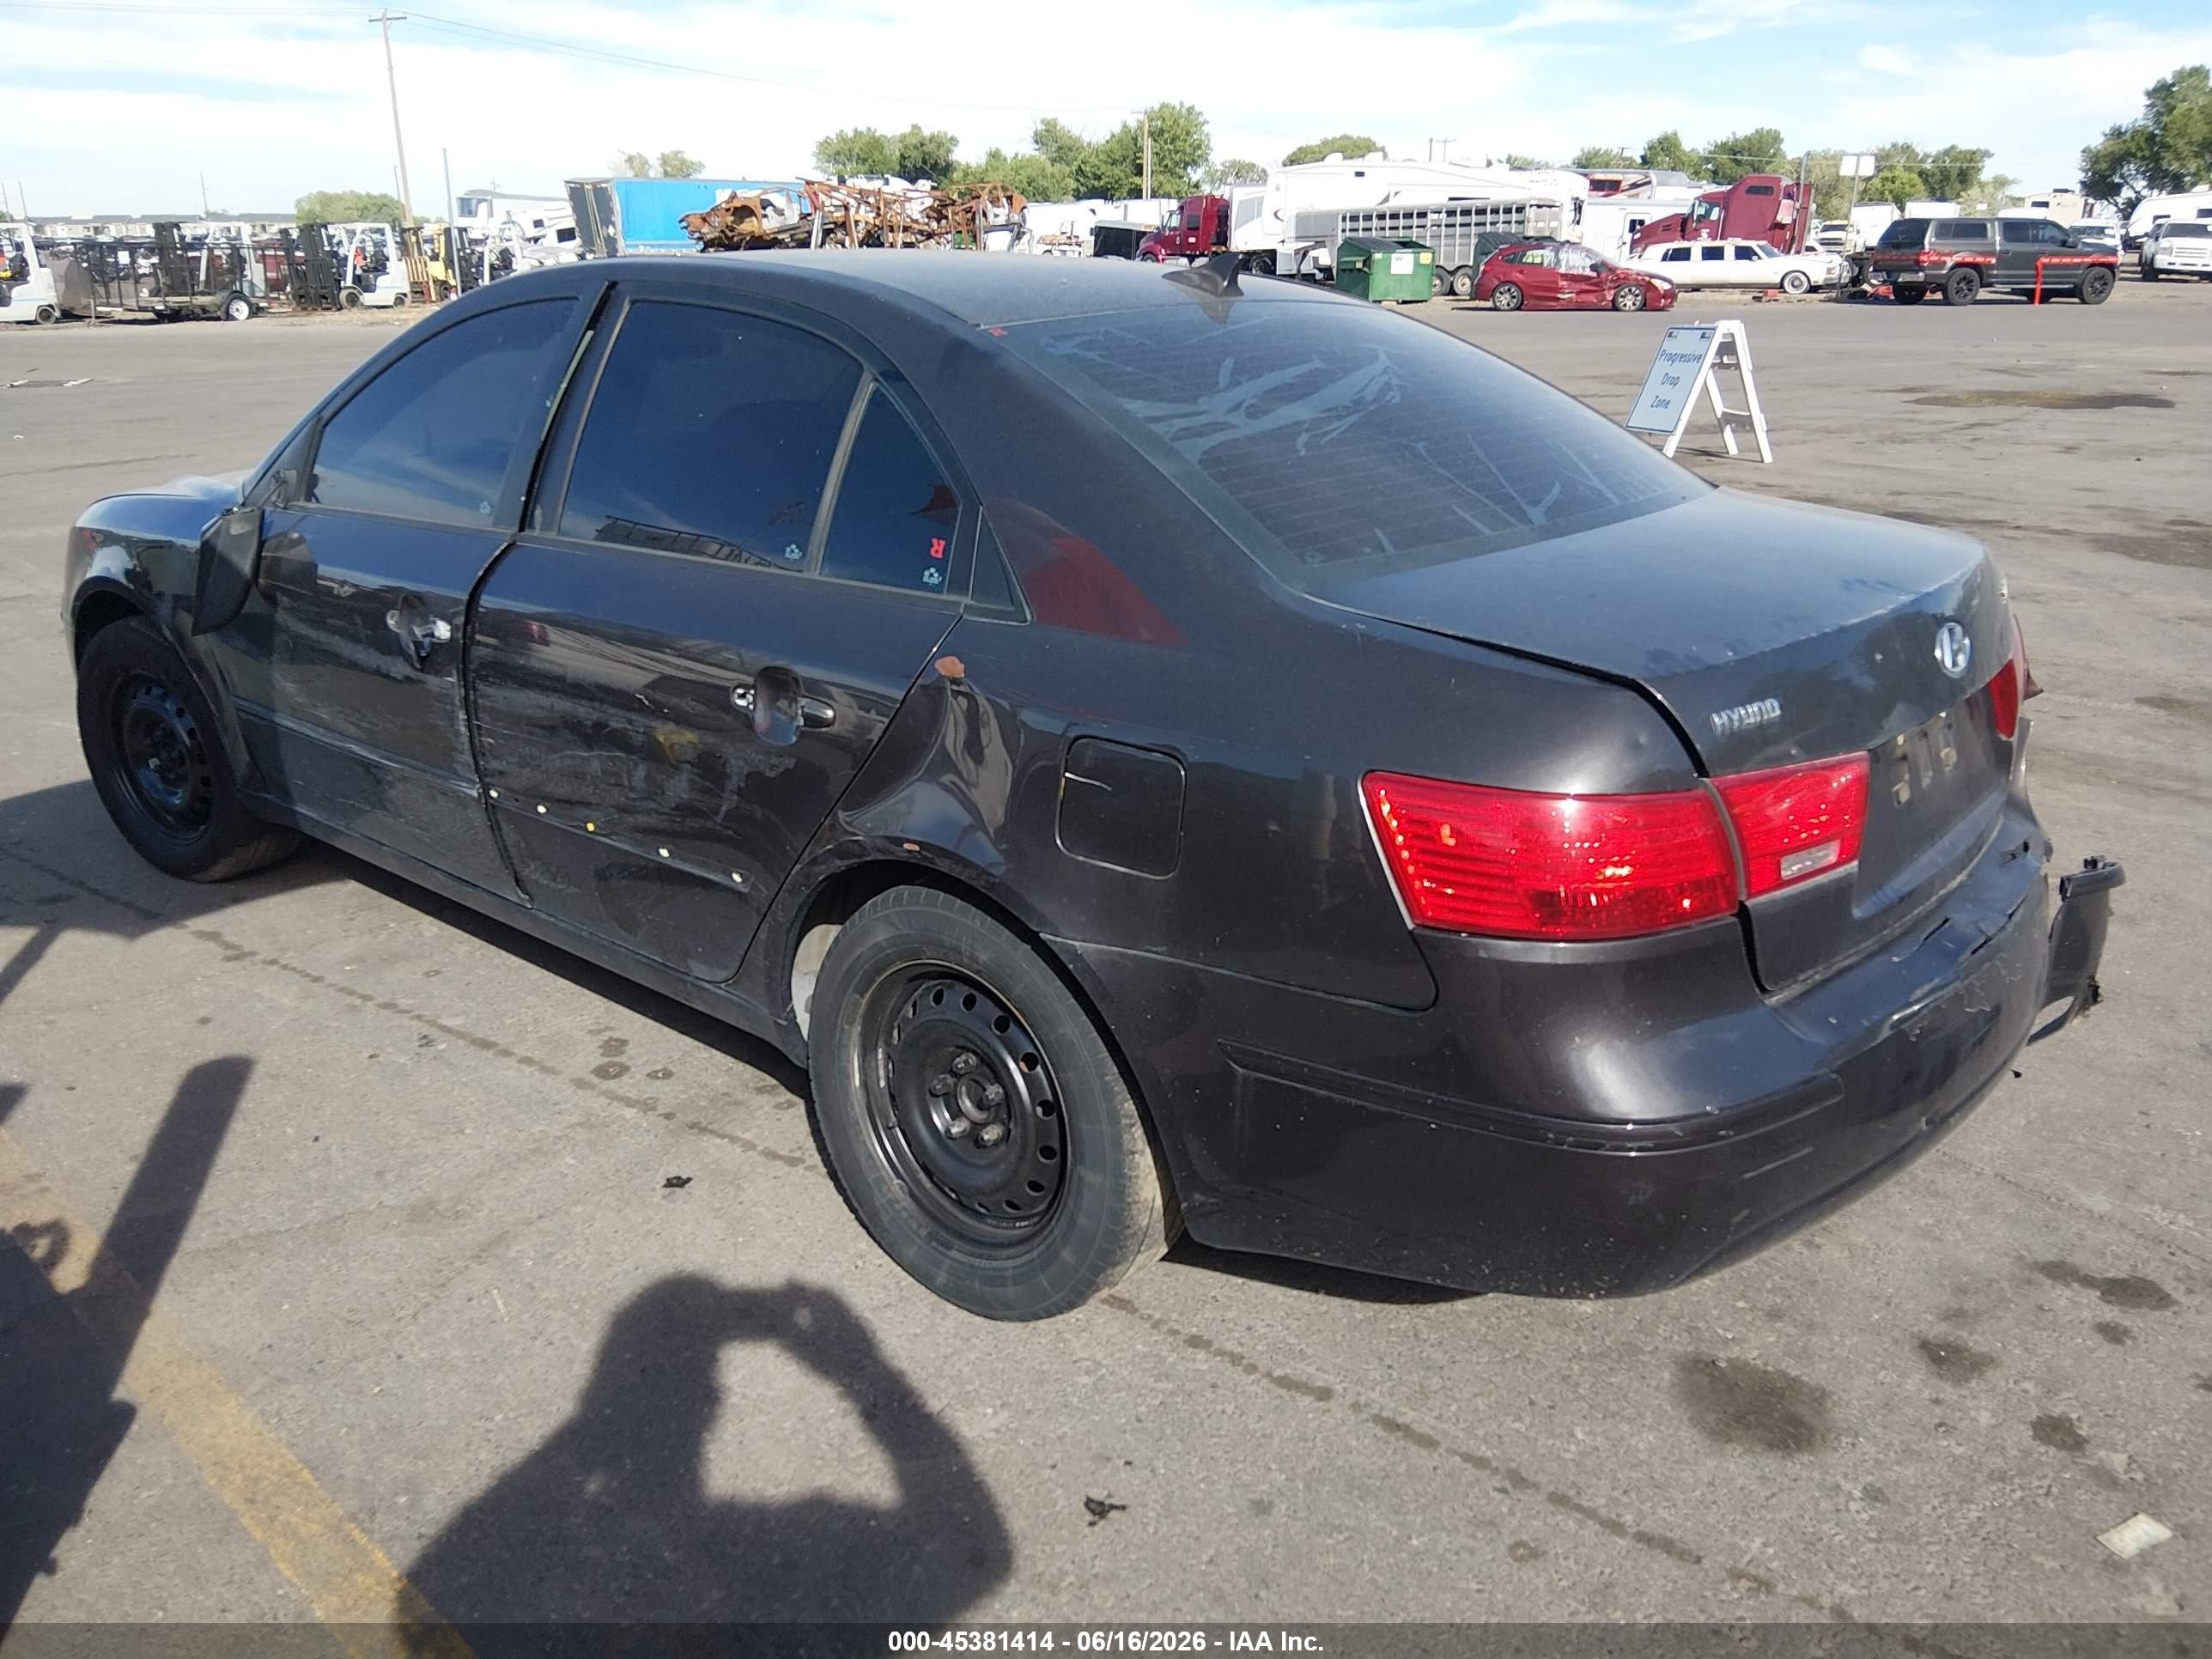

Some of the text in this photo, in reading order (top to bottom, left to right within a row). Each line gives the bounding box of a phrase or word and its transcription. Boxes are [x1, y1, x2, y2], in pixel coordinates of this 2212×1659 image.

[1658, 349, 1703, 366] Progressive
[1661, 372, 1680, 389] Drop
[1650, 395, 1671, 409] Zone
